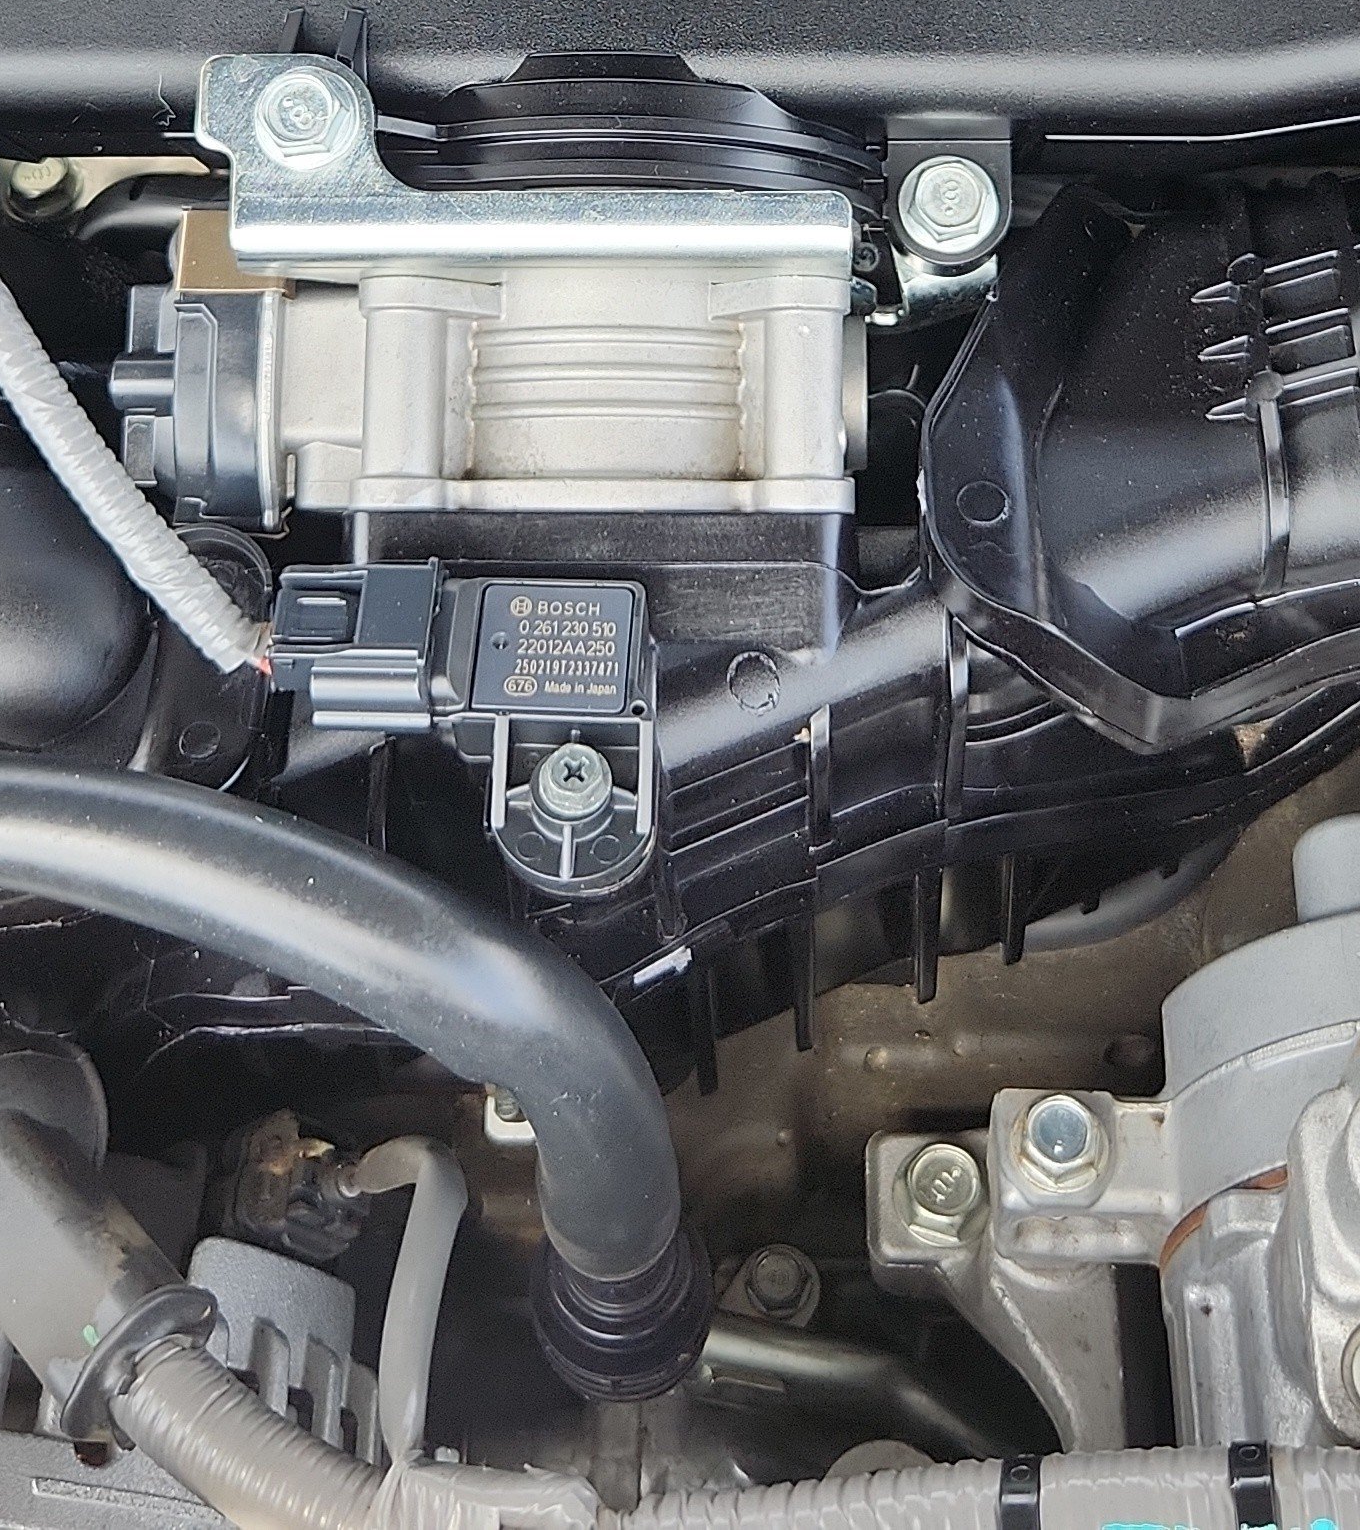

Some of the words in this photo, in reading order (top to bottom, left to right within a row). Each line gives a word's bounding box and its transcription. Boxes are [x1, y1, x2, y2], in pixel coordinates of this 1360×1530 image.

[537, 600, 601, 616] BOSCH
[519, 619, 530, 635] 0
[533, 619, 558, 636] 261
[561, 620, 589, 637] 230
[592, 621, 617, 638] 510
[517, 638, 616, 657] 22012AA250
[514, 658, 619, 677] 250219T2337471
[508, 679, 533, 692] 676
[544, 680, 572, 694] Made
[574, 681, 585, 694] in
[587, 682, 617, 696] Japan
